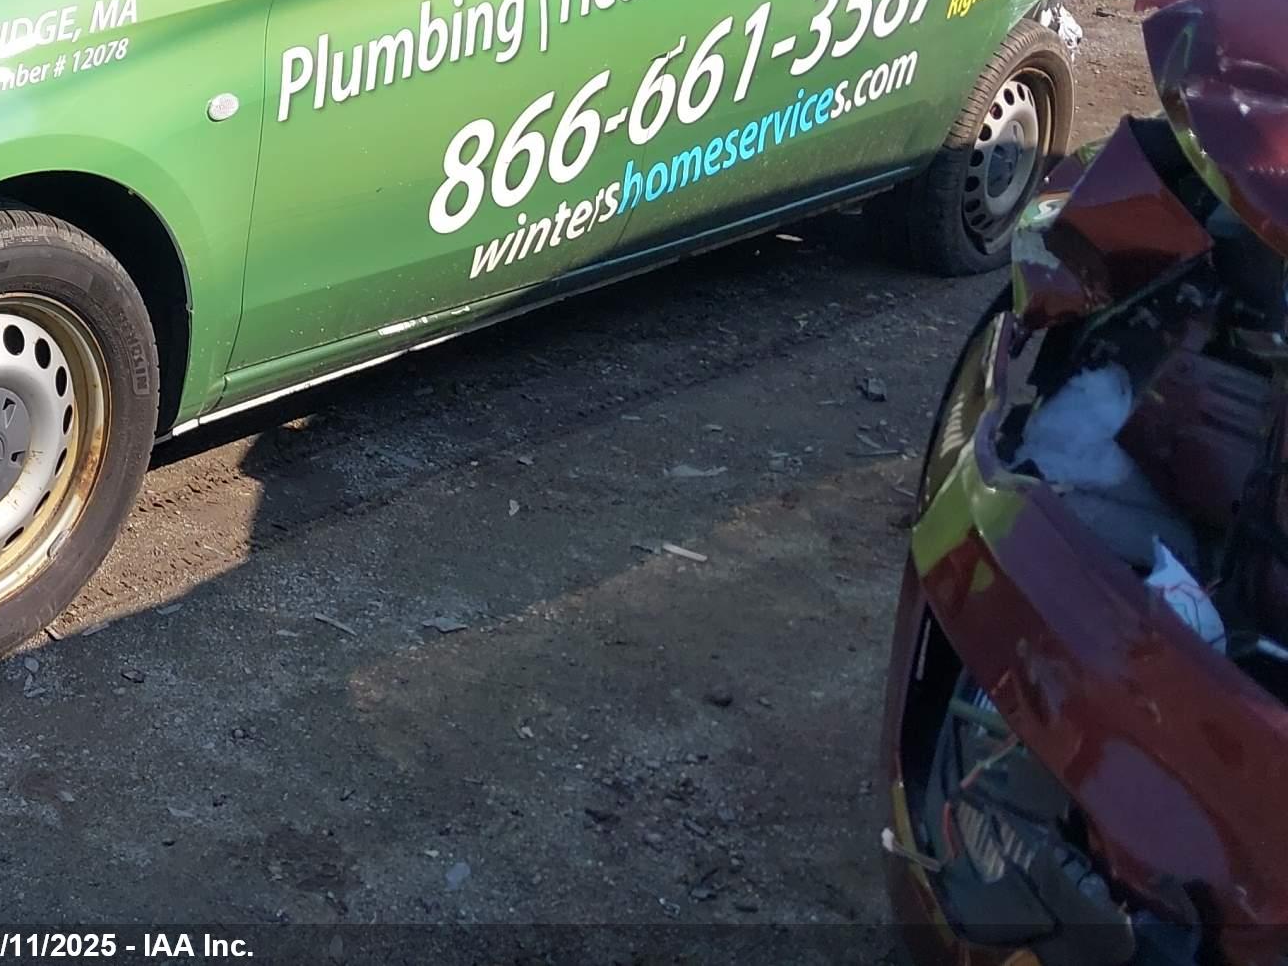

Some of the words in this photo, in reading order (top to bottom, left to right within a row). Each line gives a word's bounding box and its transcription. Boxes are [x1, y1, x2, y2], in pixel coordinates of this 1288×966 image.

[53, 55, 66, 78] #
[72, 37, 129, 73] 12078
[469, 50, 919, 280] wintershomeservices.com
